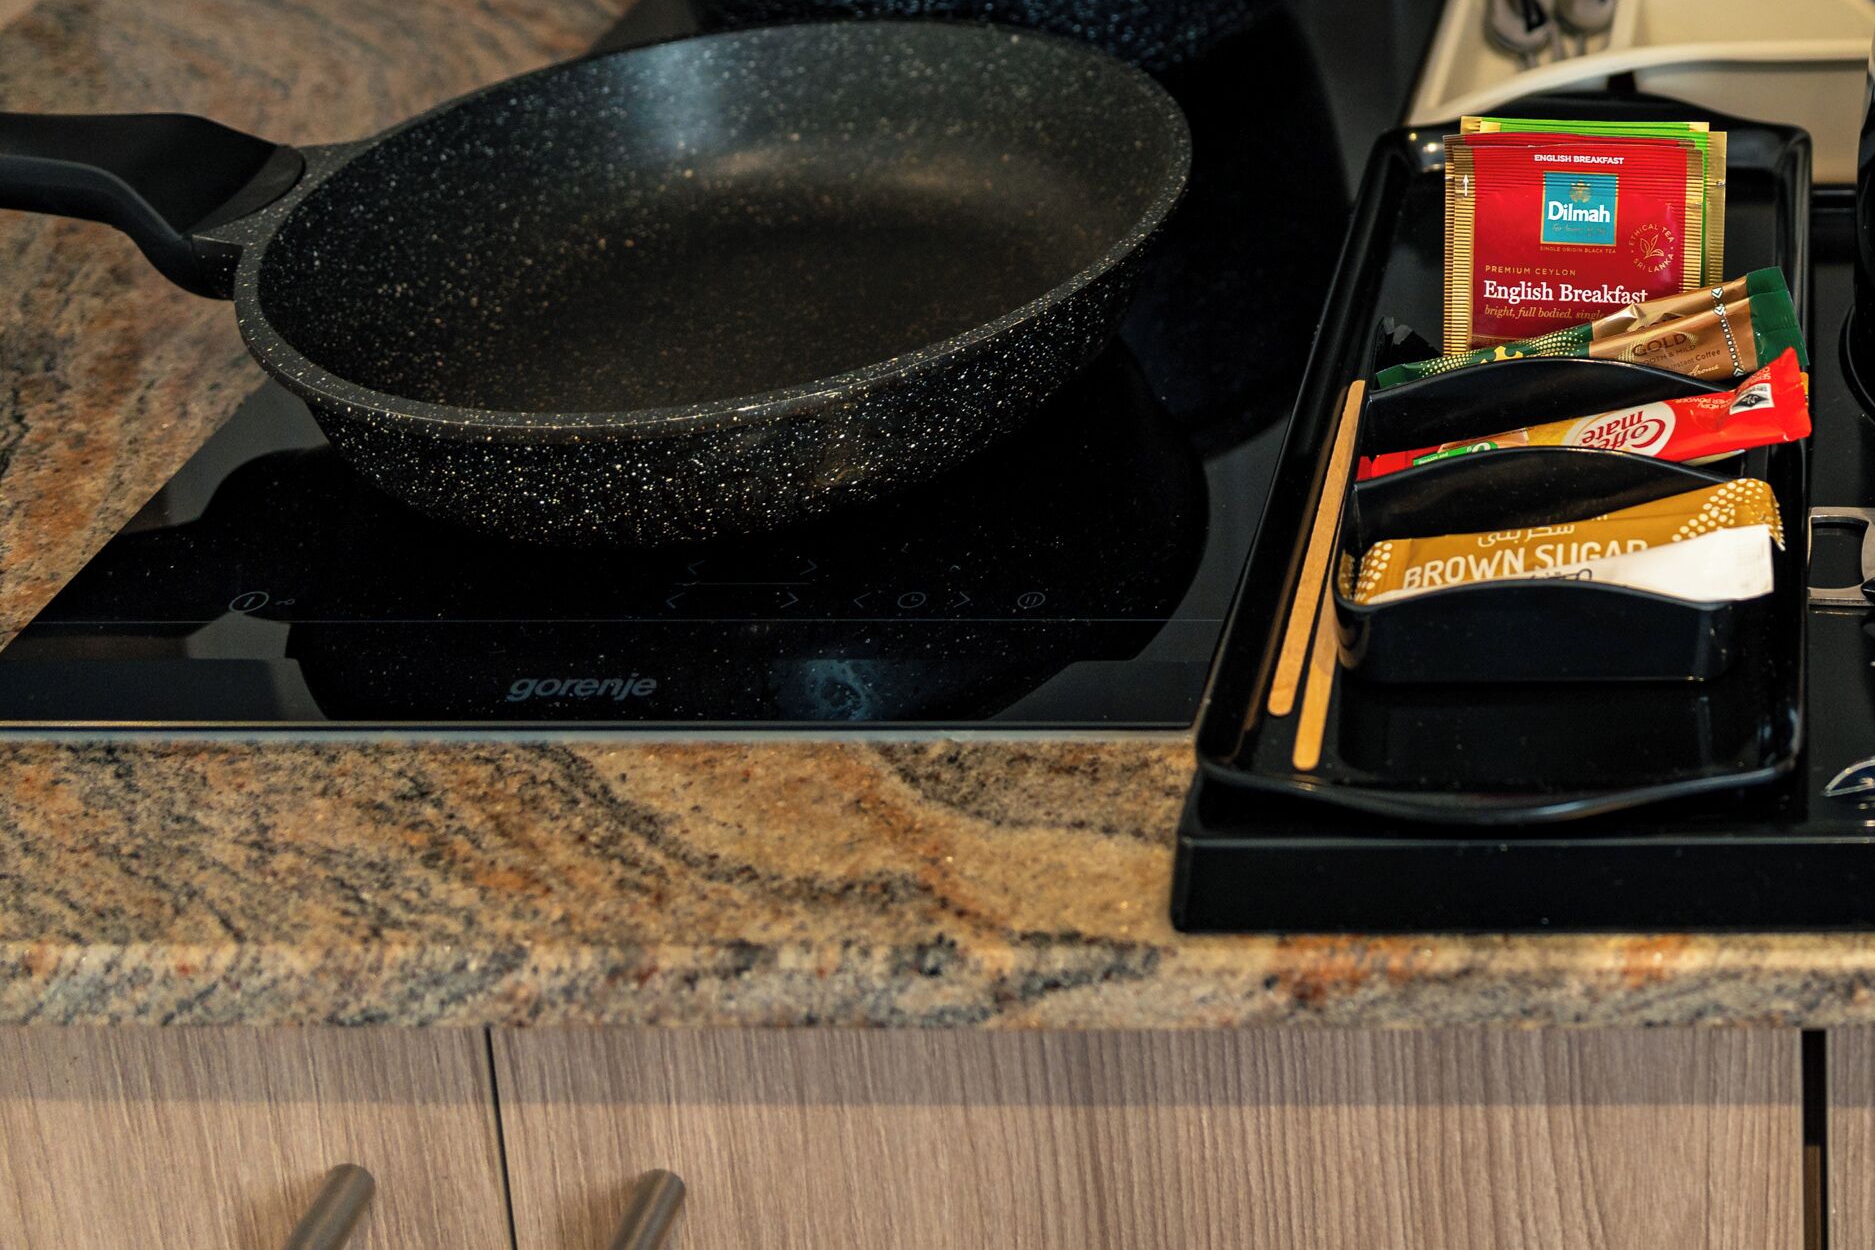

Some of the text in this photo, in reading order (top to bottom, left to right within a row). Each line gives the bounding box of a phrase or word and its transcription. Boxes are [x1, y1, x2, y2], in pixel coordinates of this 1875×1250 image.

[1534, 154, 1624, 165] ENGLISH BREAKFAST
[1547, 200, 1610, 223] Dilmah
[1628, 223, 1659, 246] ETHICAL
[1661, 226, 1675, 243] TEA
[1485, 264, 1577, 277] PREMIUM CEYLON
[1633, 253, 1675, 273] SRI LANKA
[1483, 279, 1648, 305] English Breakfast
[1484, 304, 1516, 318] bright,
[1516, 306, 1536, 320] full
[1576, 308, 1603, 321] singl
[1632, 332, 1687, 357] GOLD
[1675, 344, 1697, 356] MILD
[1695, 349, 1721, 361] Coffee
[1582, 410, 1644, 444] mate
[1587, 418, 1666, 450] Coffe
[1403, 547, 1525, 590] BROWN
[506, 672, 657, 701] gorenje
